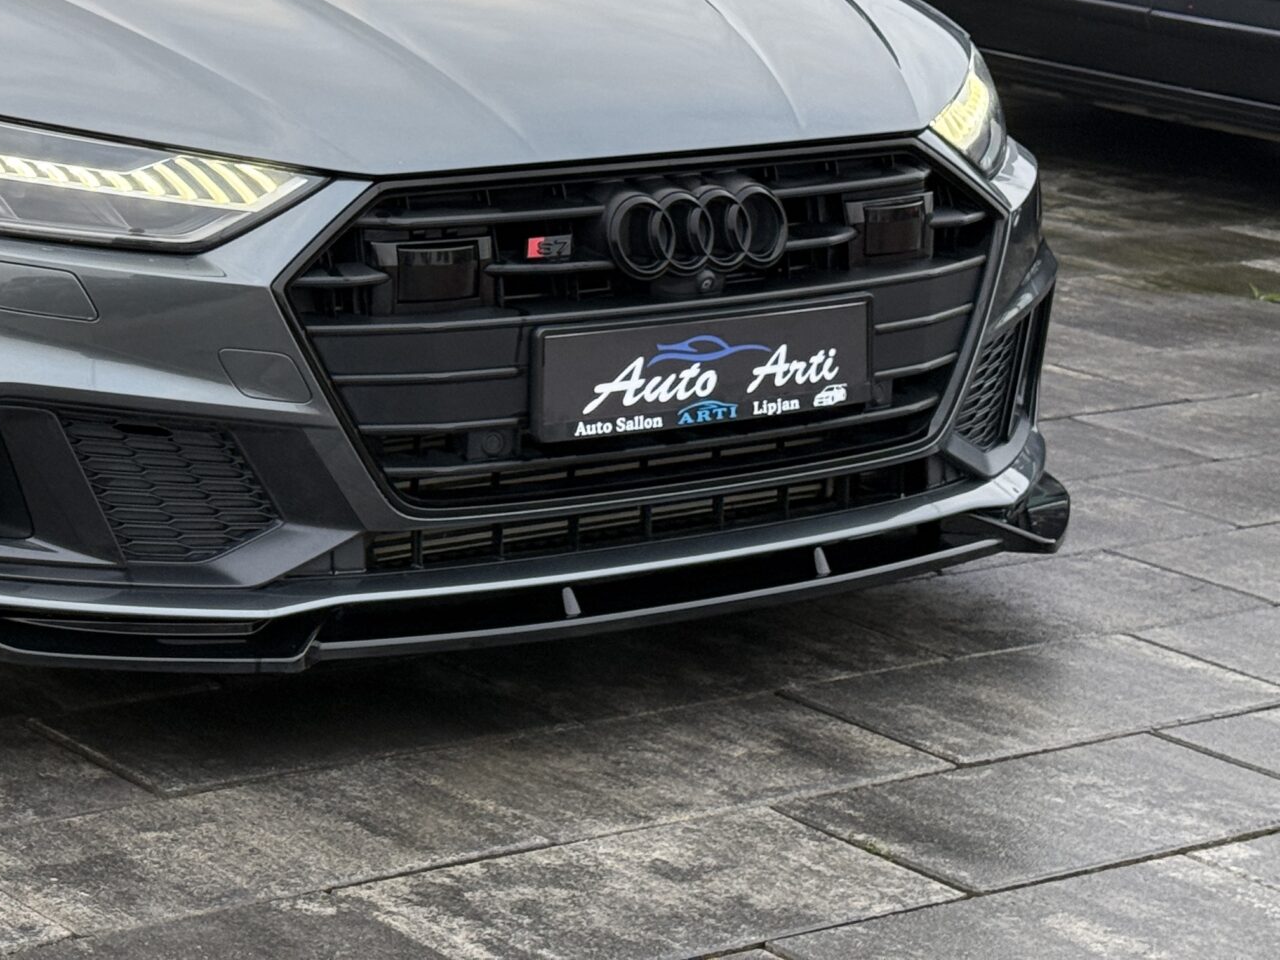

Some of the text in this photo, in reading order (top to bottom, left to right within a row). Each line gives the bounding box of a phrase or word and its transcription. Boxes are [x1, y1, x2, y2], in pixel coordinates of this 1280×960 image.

[536, 239, 568, 256] S7
[582, 343, 840, 415] Auto Arti
[677, 404, 739, 426] ARTI
[753, 397, 800, 416] Lipjan
[574, 415, 664, 437] Auto Sallon
